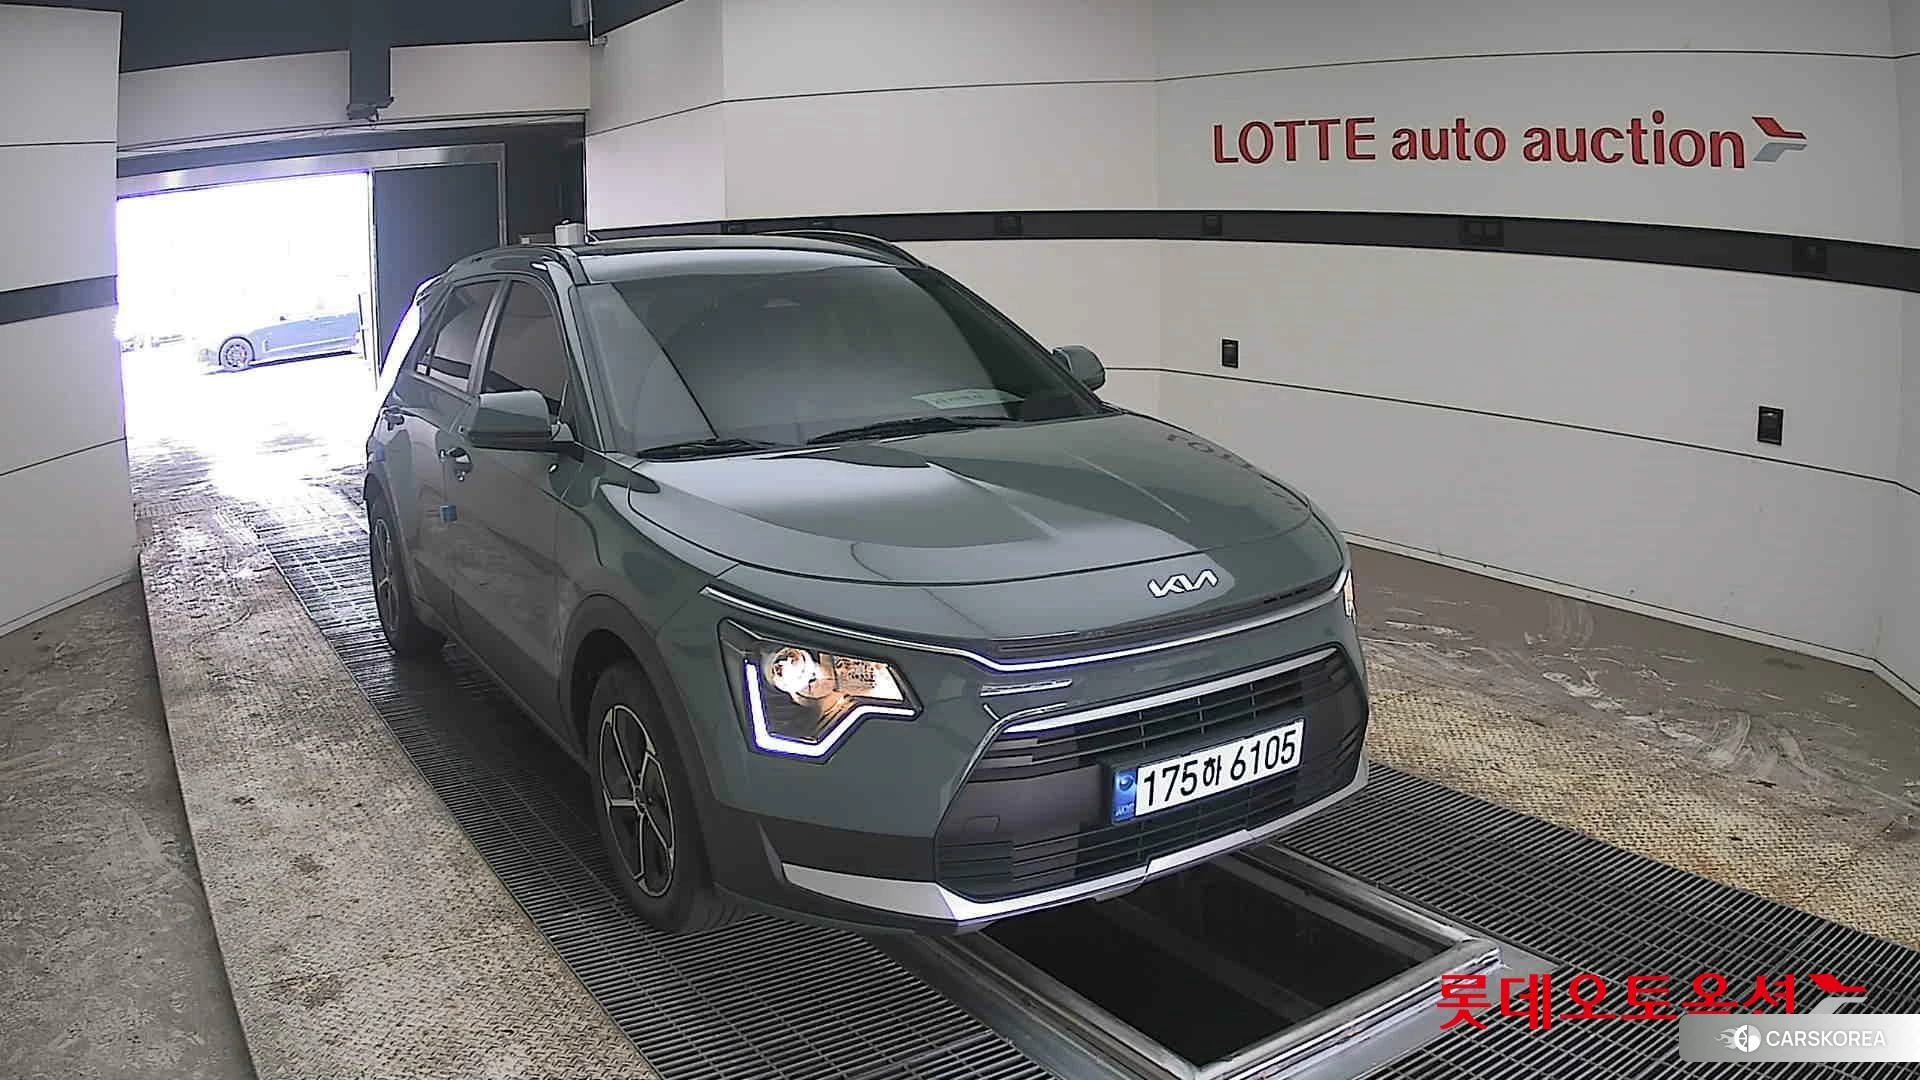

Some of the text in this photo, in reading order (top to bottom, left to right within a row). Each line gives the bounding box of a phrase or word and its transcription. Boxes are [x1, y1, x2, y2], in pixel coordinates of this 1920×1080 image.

[1212, 110, 1747, 169] LOTTE auto auction
[1143, 729, 1297, 807] 175하 6105
